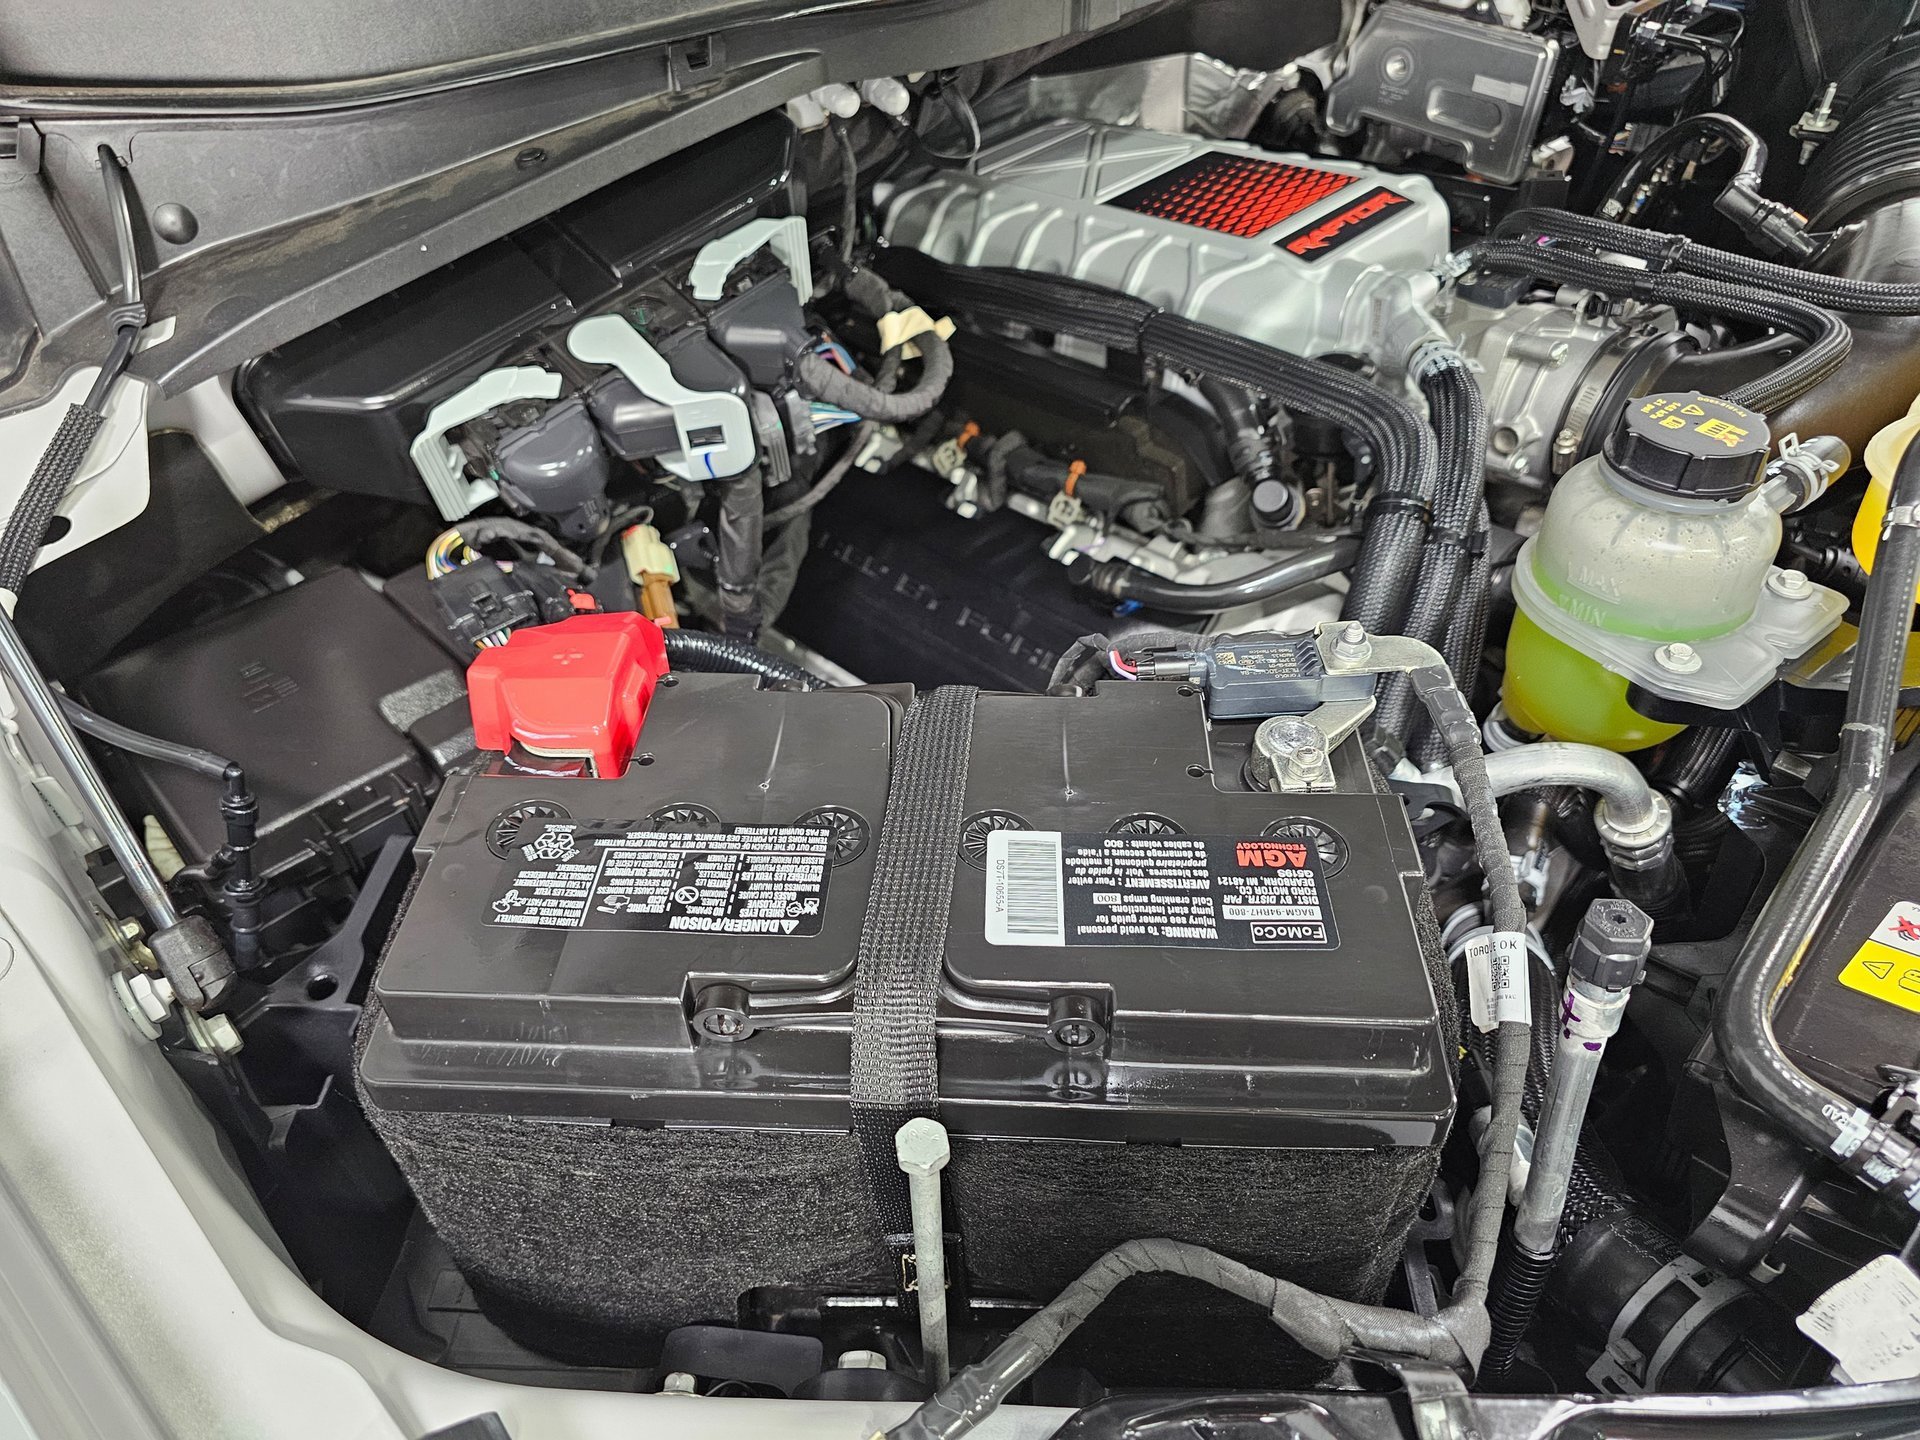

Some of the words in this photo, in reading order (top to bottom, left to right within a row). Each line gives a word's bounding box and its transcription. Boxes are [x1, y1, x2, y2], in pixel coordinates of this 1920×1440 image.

[1286, 192, 1407, 254] RAPTOR
[1579, 566, 1620, 597] MAX
[770, 827, 778, 835] LA
[811, 844, 827, 852] KEEP
[1193, 841, 1205, 849] de
[801, 857, 825, 865] BLESSER
[1104, 858, 1112, 866] la
[1236, 850, 1307, 867] AGM
[642, 860, 663, 868] CAUSER
[723, 863, 735, 871] LES
[750, 864, 776, 872] PEUVENT
[776, 864, 810, 873] EXPLOSIFS
[810, 865, 823, 873] GAZ
[1075, 867, 1086, 876] du
[1088, 866, 1112, 876] guide
[1114, 868, 1123, 876] le
[1125, 868, 1143, 876] Voir
[1146, 868, 1191, 877] blessures.
[559, 872, 594, 880] CONSULTEZ
[741, 872, 753, 880] LES
[753, 872, 773, 881] YEUX
[774, 873, 787, 881] LES
[1193, 869, 1209, 877] des
[1095, 877, 1115, 885] Pour
[1125, 878, 1210, 889] AVERTISSEMENT
[1218, 877, 1244, 885] 48121
[1246, 877, 1258, 885] MI
[1260, 876, 1315, 886] DEARBORN,
[596, 886, 632, 894] BLINDNESS
[773, 883, 783, 891] OR
[784, 884, 820, 892] BLINDNESS
[996, 859, 1004, 913] DS7T-10655-A
[1235, 886, 1252, 894] CO.
[1254, 886, 1288, 894] MOTOR
[552, 888, 564, 896] LES
[738, 891, 759, 899] CAUSE
[760, 891, 773, 899] CAN
[1291, 887, 1317, 895] FORD
[647, 895, 667, 904] ACID
[774, 892, 797, 900] GASES
[1097, 895, 1117, 903] 800
[1123, 894, 1148, 903] amps
[1150, 894, 1190, 905] cranking
[1223, 894, 1242, 903] PAR
[1245, 895, 1276, 904] DISTR.
[1280, 896, 1292, 904] BY
[1294, 896, 1319, 904] DIST.
[542, 899, 558, 907] HELP
[559, 900, 585, 908] MEDICAL
[747, 900, 787, 908] EXPLOSIVE
[1192, 897, 1213, 906] Cold
[524, 907, 538, 915] GET
[626, 903, 665, 913] SULFURIC
[685, 905, 713, 914] SPARKS,
[713, 907, 724, 916] NO
[1109, 905, 1165, 915] instructions.
[1168, 906, 1188, 915] start
[1191, 904, 1214, 915] jump
[1229, 907, 1314, 916] BAGM-94RH7-800
[564, 909, 581, 917] WITH
[739, 909, 758, 917] EYES
[759, 909, 785, 917] SHIELD
[494, 914, 539, 924] IMMEDIATELY
[540, 917, 556, 925] EYES
[557, 918, 579, 926] FLUSH
[1095, 915, 1109, 923] for
[1111, 914, 1136, 924] guide
[1139, 915, 1167, 923] owner
[1170, 916, 1187, 925] see
[1189, 915, 1215, 925] injury
[669, 917, 780, 932] DANGER/POISON
[1078, 923, 1117, 934] personal
[1120, 925, 1145, 935] avoid
[1147, 926, 1159, 935] To
[1161, 926, 1218, 939] WARNING:
[1254, 926, 1323, 938] FoMoCo
[1500, 940, 1517, 950] OK
